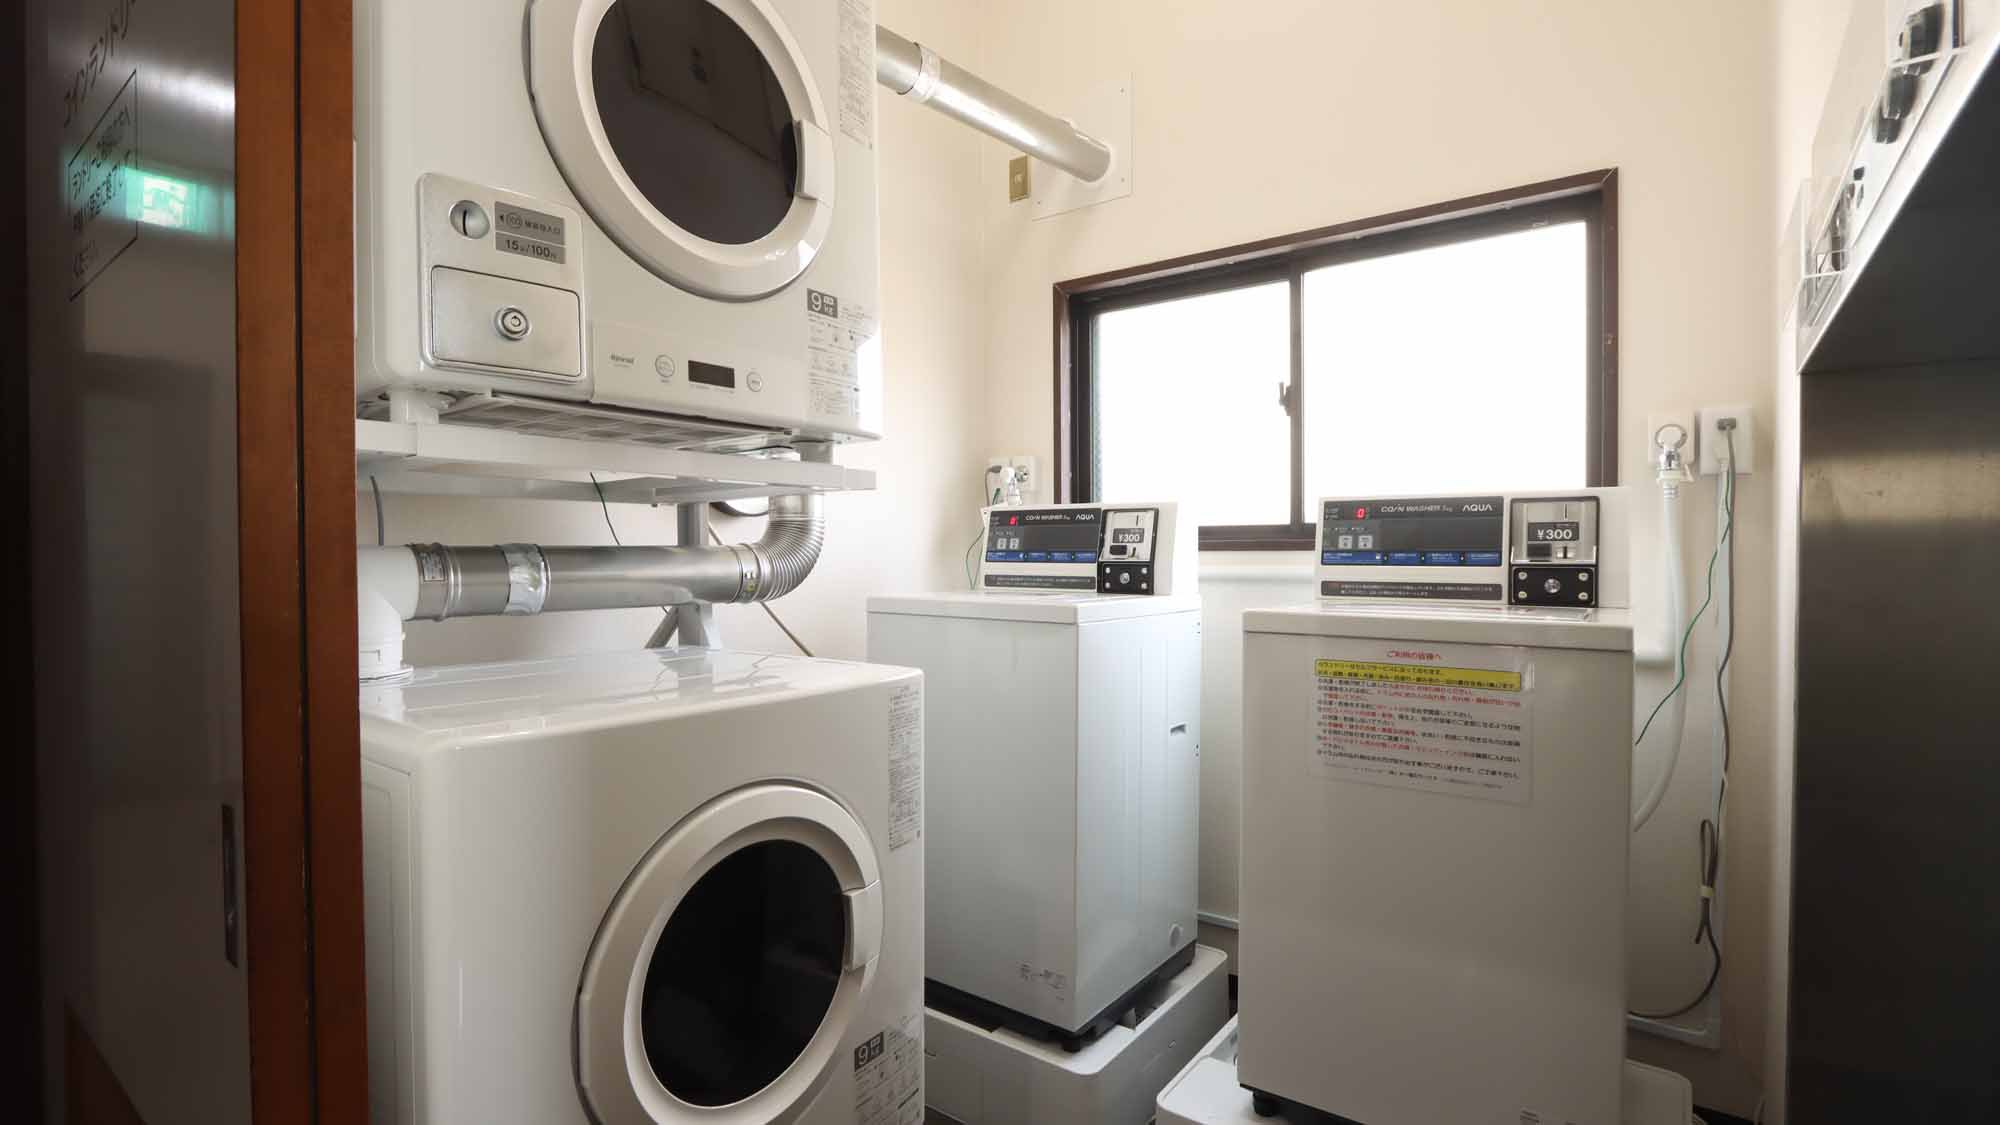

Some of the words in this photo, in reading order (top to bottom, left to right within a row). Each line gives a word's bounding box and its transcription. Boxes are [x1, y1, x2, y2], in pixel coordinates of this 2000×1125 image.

[64, 0, 136, 128] コインランドリ
[811, 292, 822, 312] 9
[1462, 503, 1493, 512] AQUA
[1536, 528, 1573, 540] ¥300
[858, 1046, 869, 1065] 9
